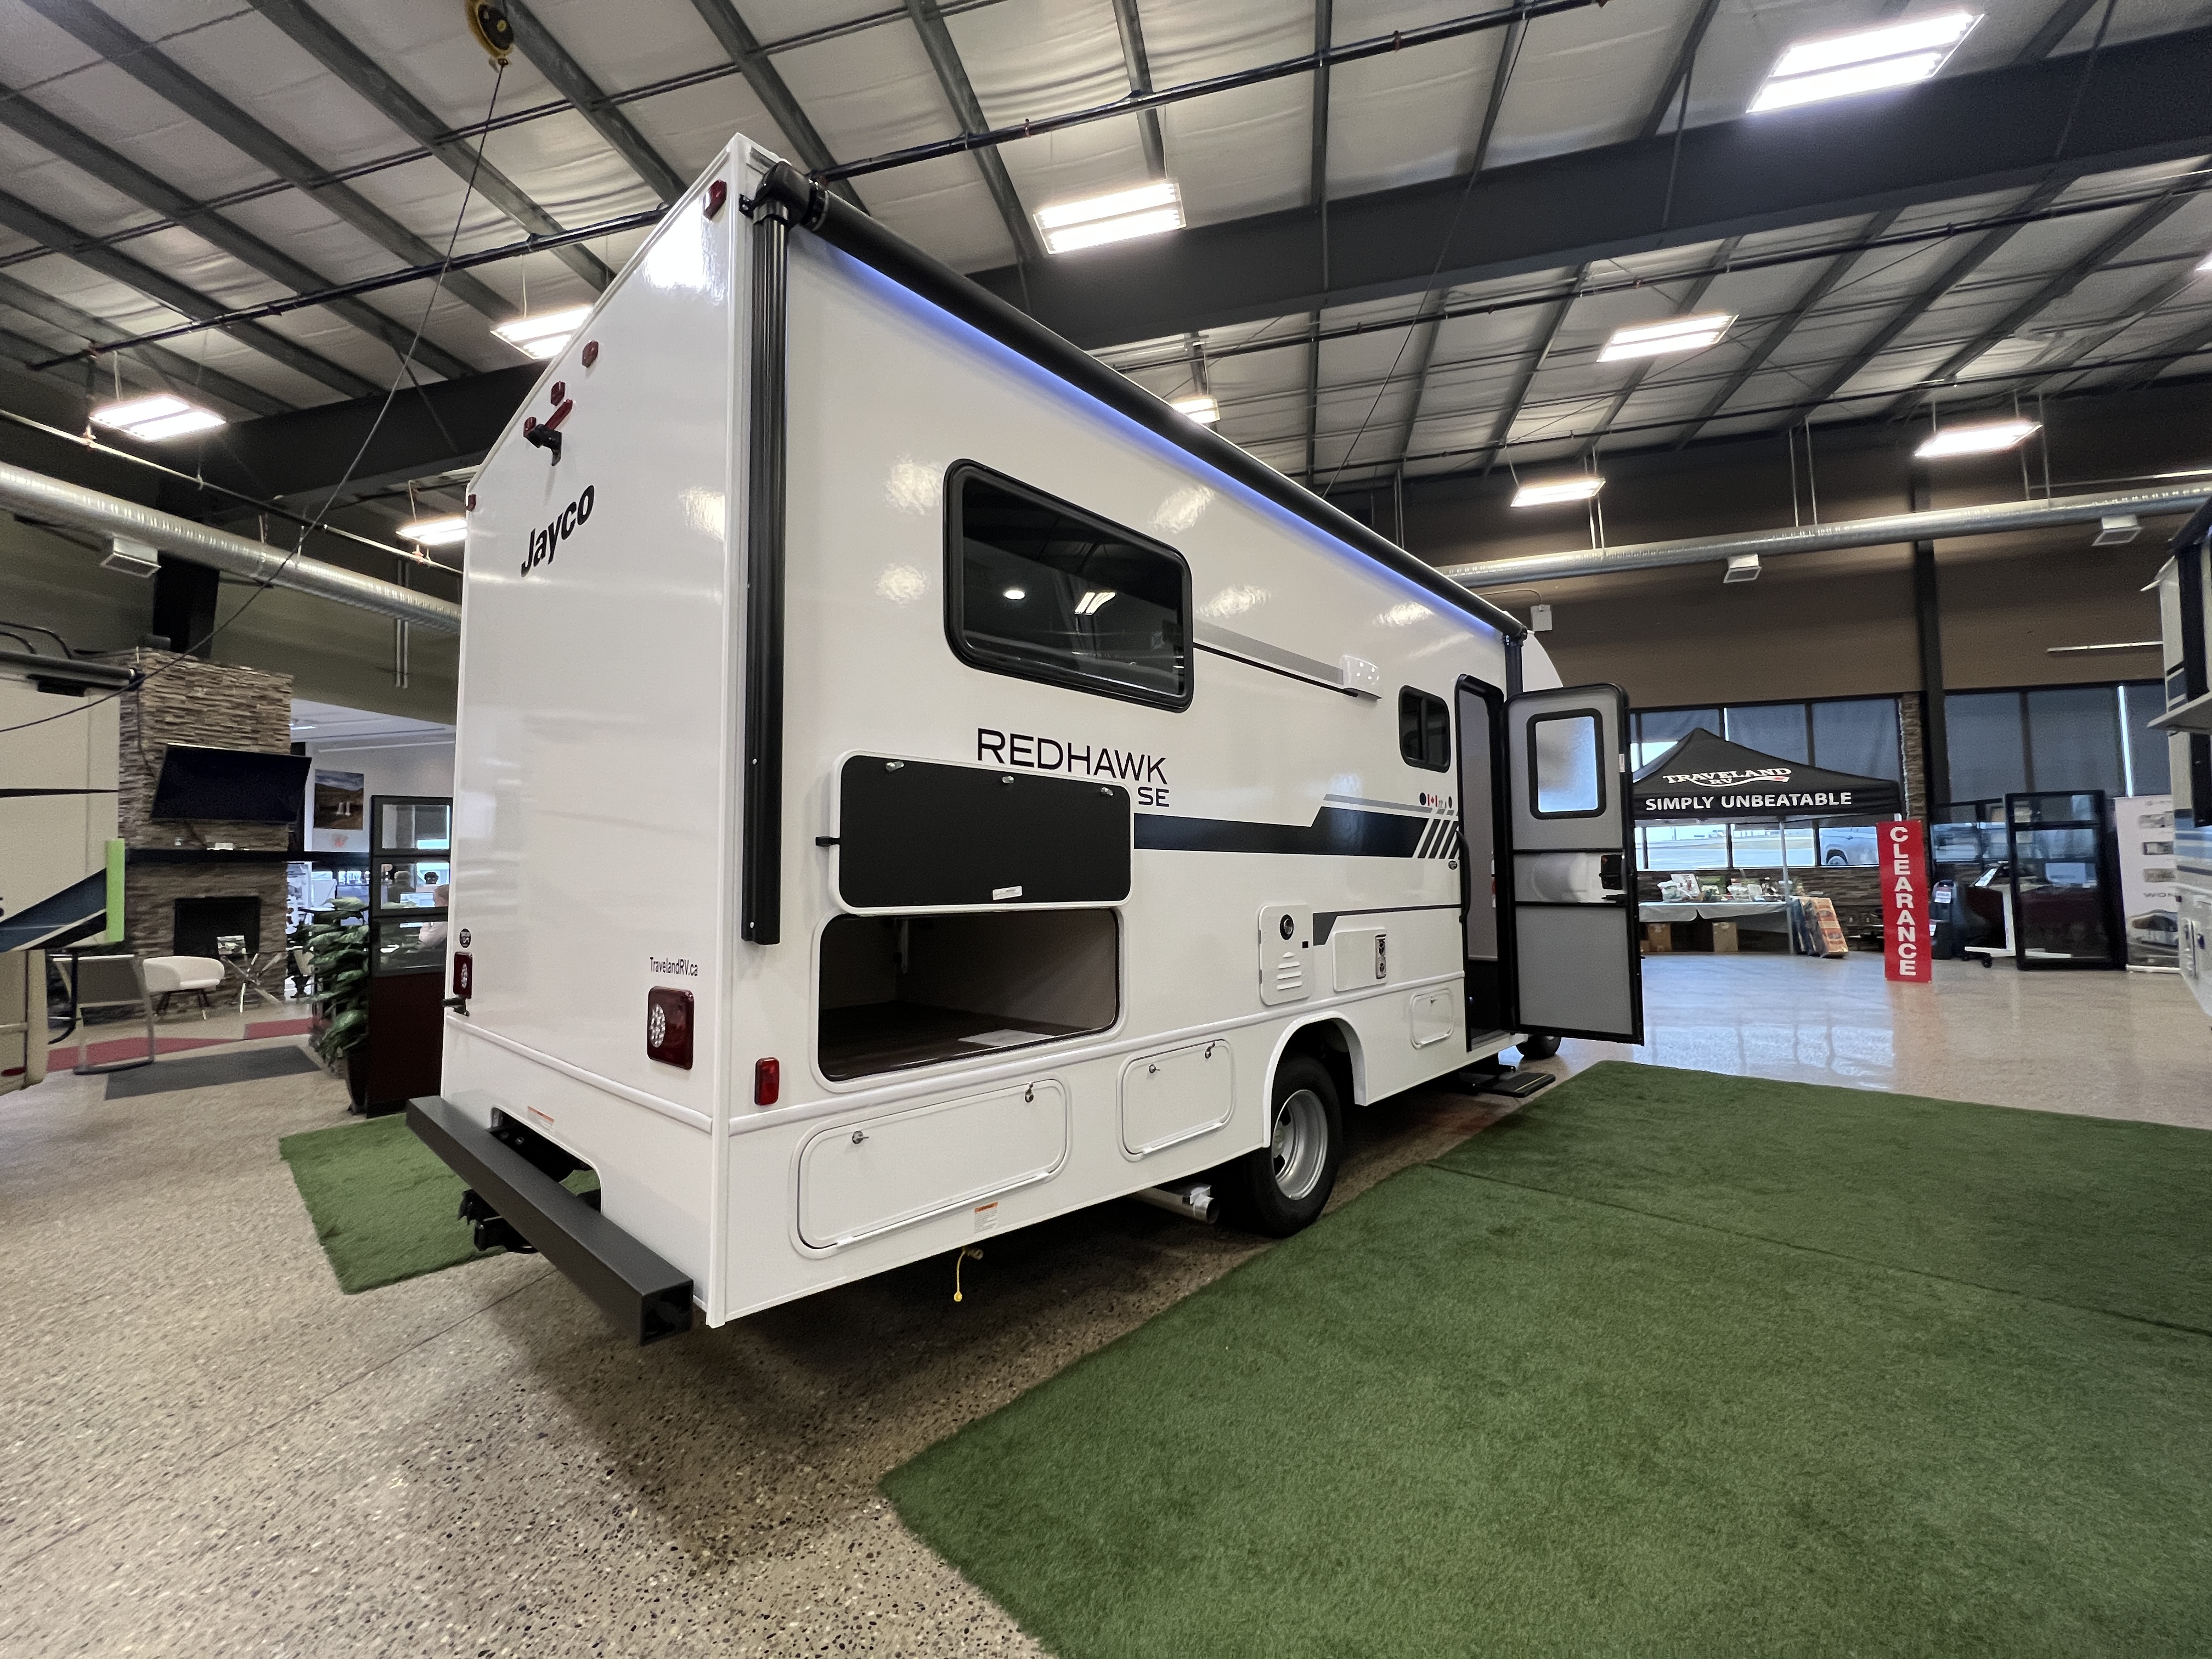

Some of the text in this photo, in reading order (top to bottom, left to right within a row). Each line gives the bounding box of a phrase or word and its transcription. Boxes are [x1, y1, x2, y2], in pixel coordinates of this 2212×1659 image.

[521, 484, 595, 578] Jayco
[977, 728, 1167, 785] REDHAWK
[1663, 768, 1792, 784] TRAVELAND
[1138, 787, 1170, 808] SE
[1646, 792, 1852, 811] SIMPLY UNBEATABLE
[1890, 827, 1916, 977] CLEARANCE
[650, 957, 698, 976] TravelandRV.ca
